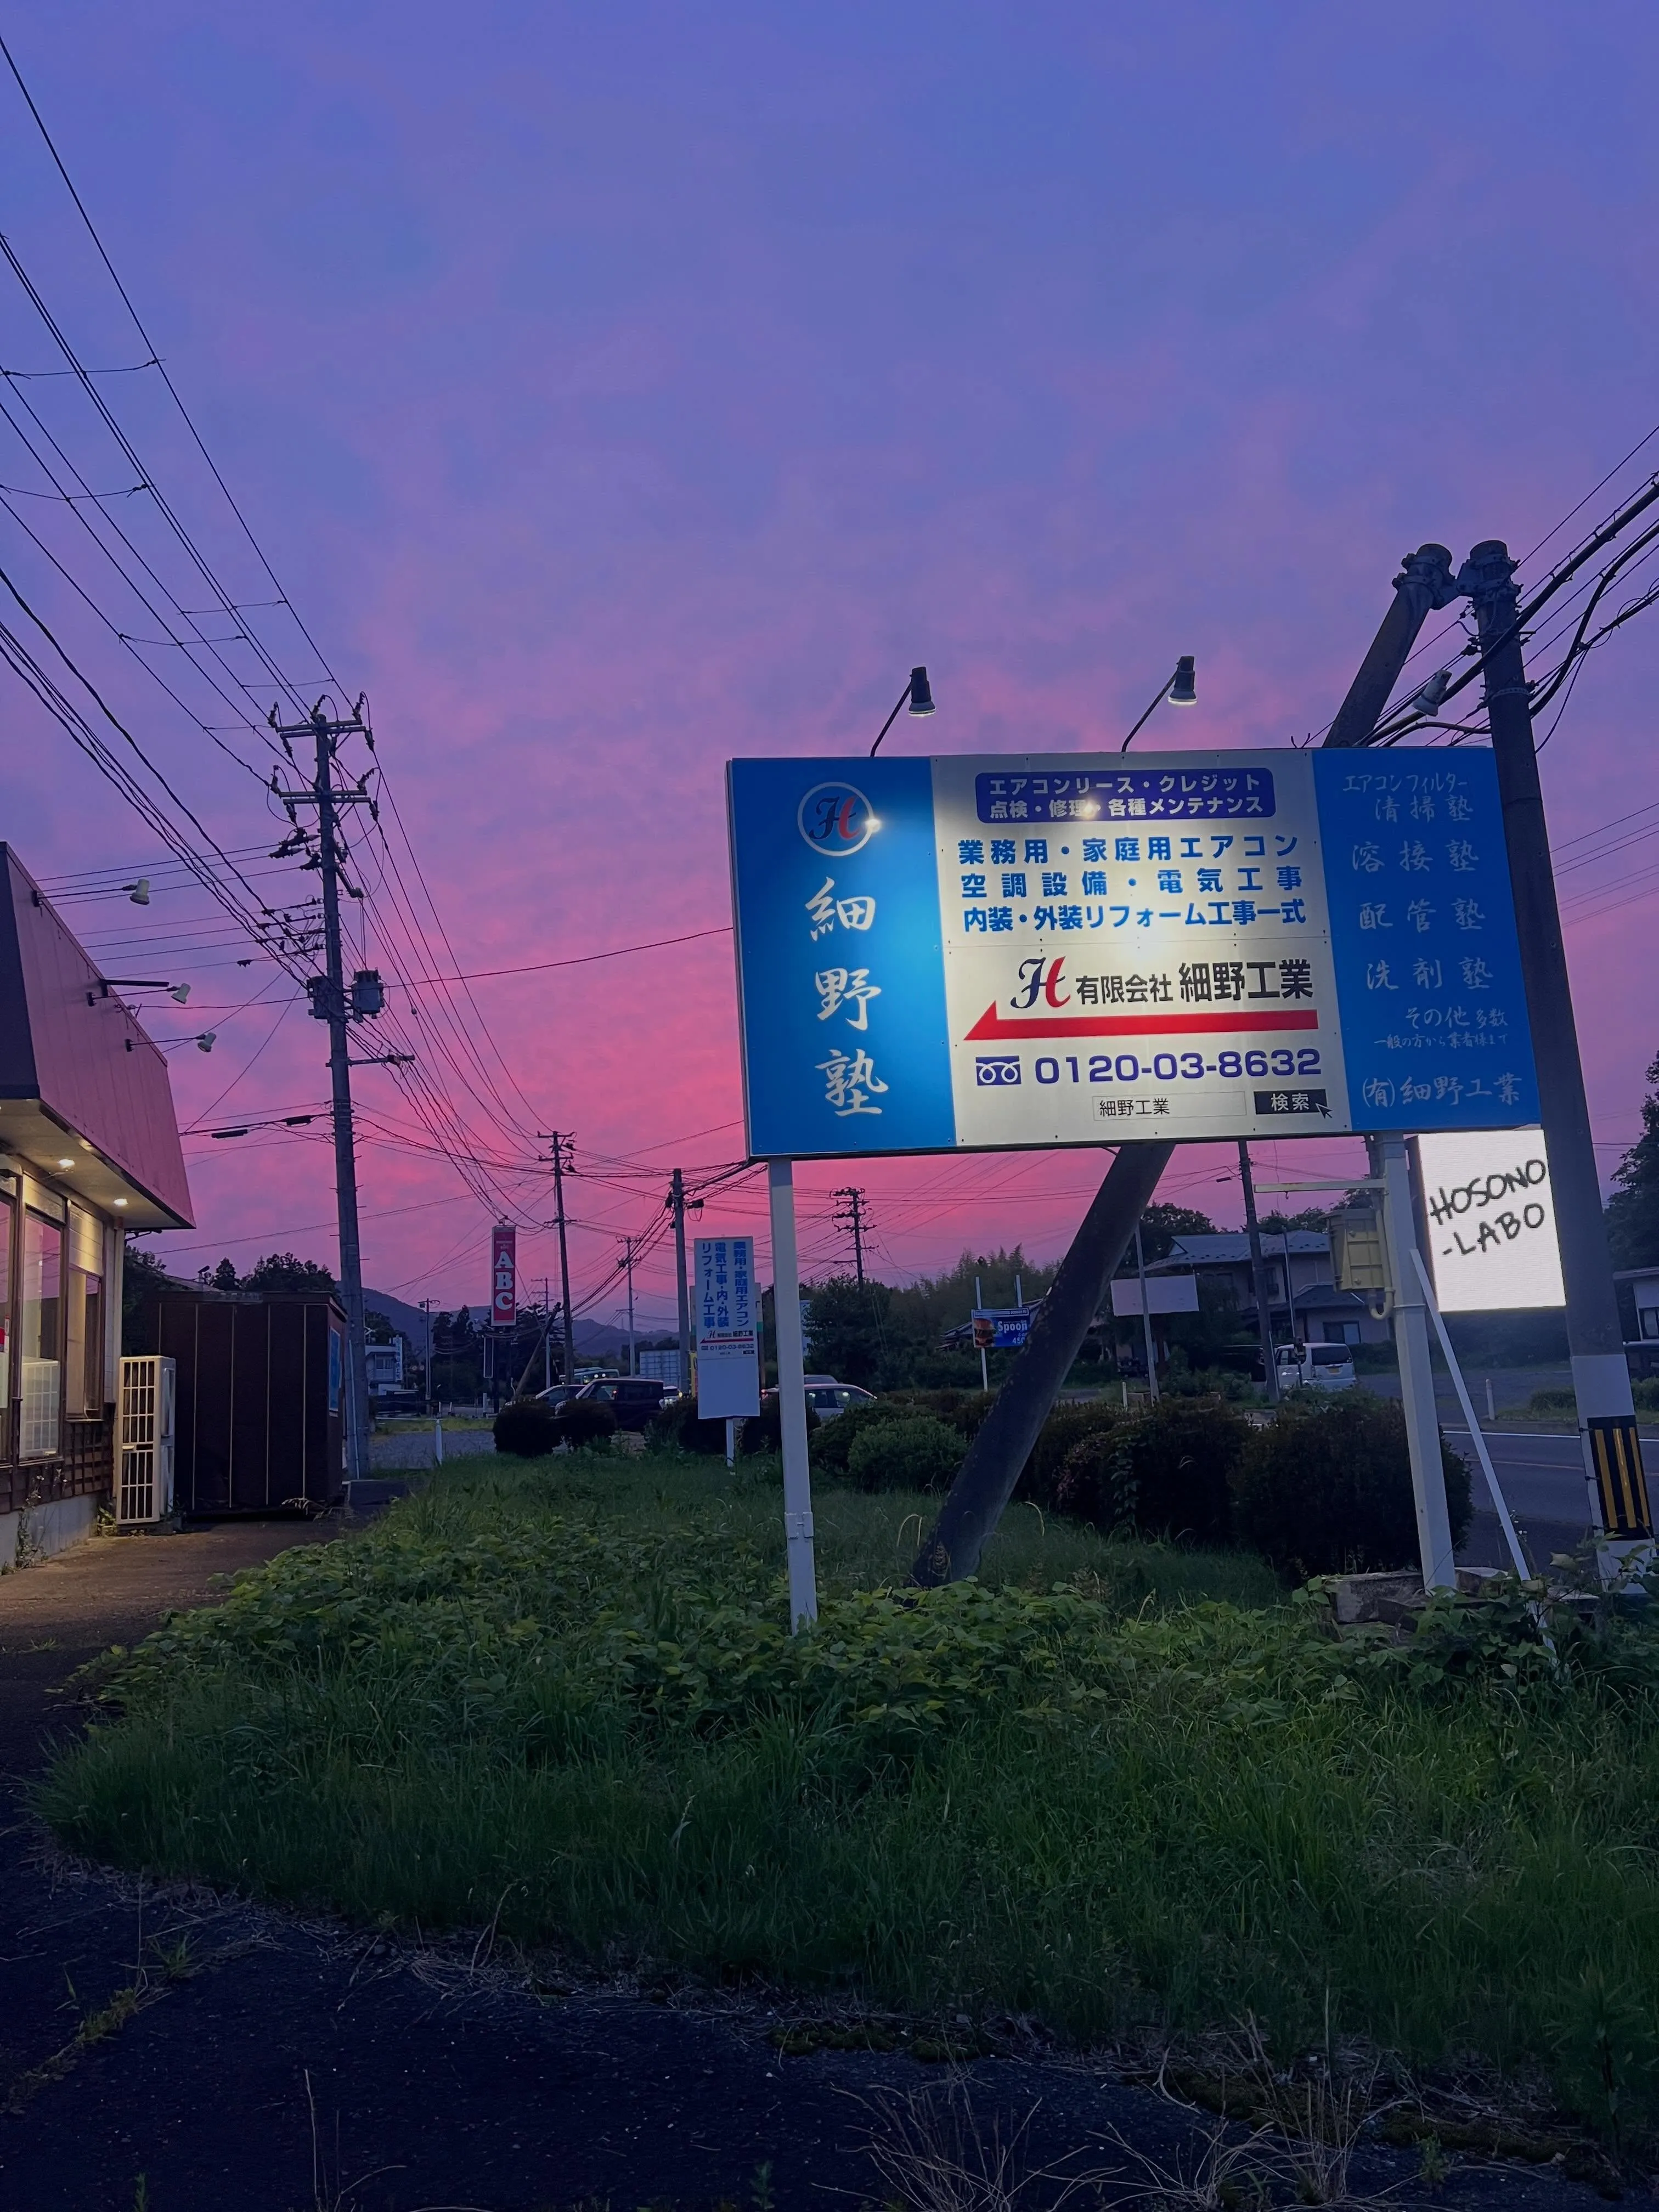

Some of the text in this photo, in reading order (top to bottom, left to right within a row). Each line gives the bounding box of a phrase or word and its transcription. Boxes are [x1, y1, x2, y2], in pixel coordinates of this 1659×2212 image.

[990, 773, 1260, 795] エアコンリース・クレジット
[1343, 772, 1467, 793] エアコンフィルター
[990, 797, 1263, 820] 点検・修理・各種メンテナンス
[1375, 794, 1474, 823] 清掃塾
[958, 834, 1298, 866] 業務用・家庭用エアコン
[1352, 839, 1480, 873] 溶接塾
[961, 865, 1302, 899] 空調設備・電気工事
[963, 898, 1307, 933] 内装・外装リフォーム工事一式
[1359, 898, 1486, 933] 配管塾
[1075, 958, 1314, 1006] 有限会社 細野工業
[1367, 956, 1494, 990] 洗剤塾
[804, 877, 889, 1116] 細野塾
[1405, 1006, 1508, 1029] その他多数
[1035, 1048, 1322, 1084] 0120-03-8632
[1099, 1097, 1171, 1116] 細野工業
[1271, 1093, 1309, 1112] 検索
[1430, 1159, 1546, 1226] HOSONO
[495, 1251, 514, 1310] ABC
[702, 1242, 715, 1329] リフォーム工事
[733, 1241, 750, 1327] 業務用・家庭用エアコン
